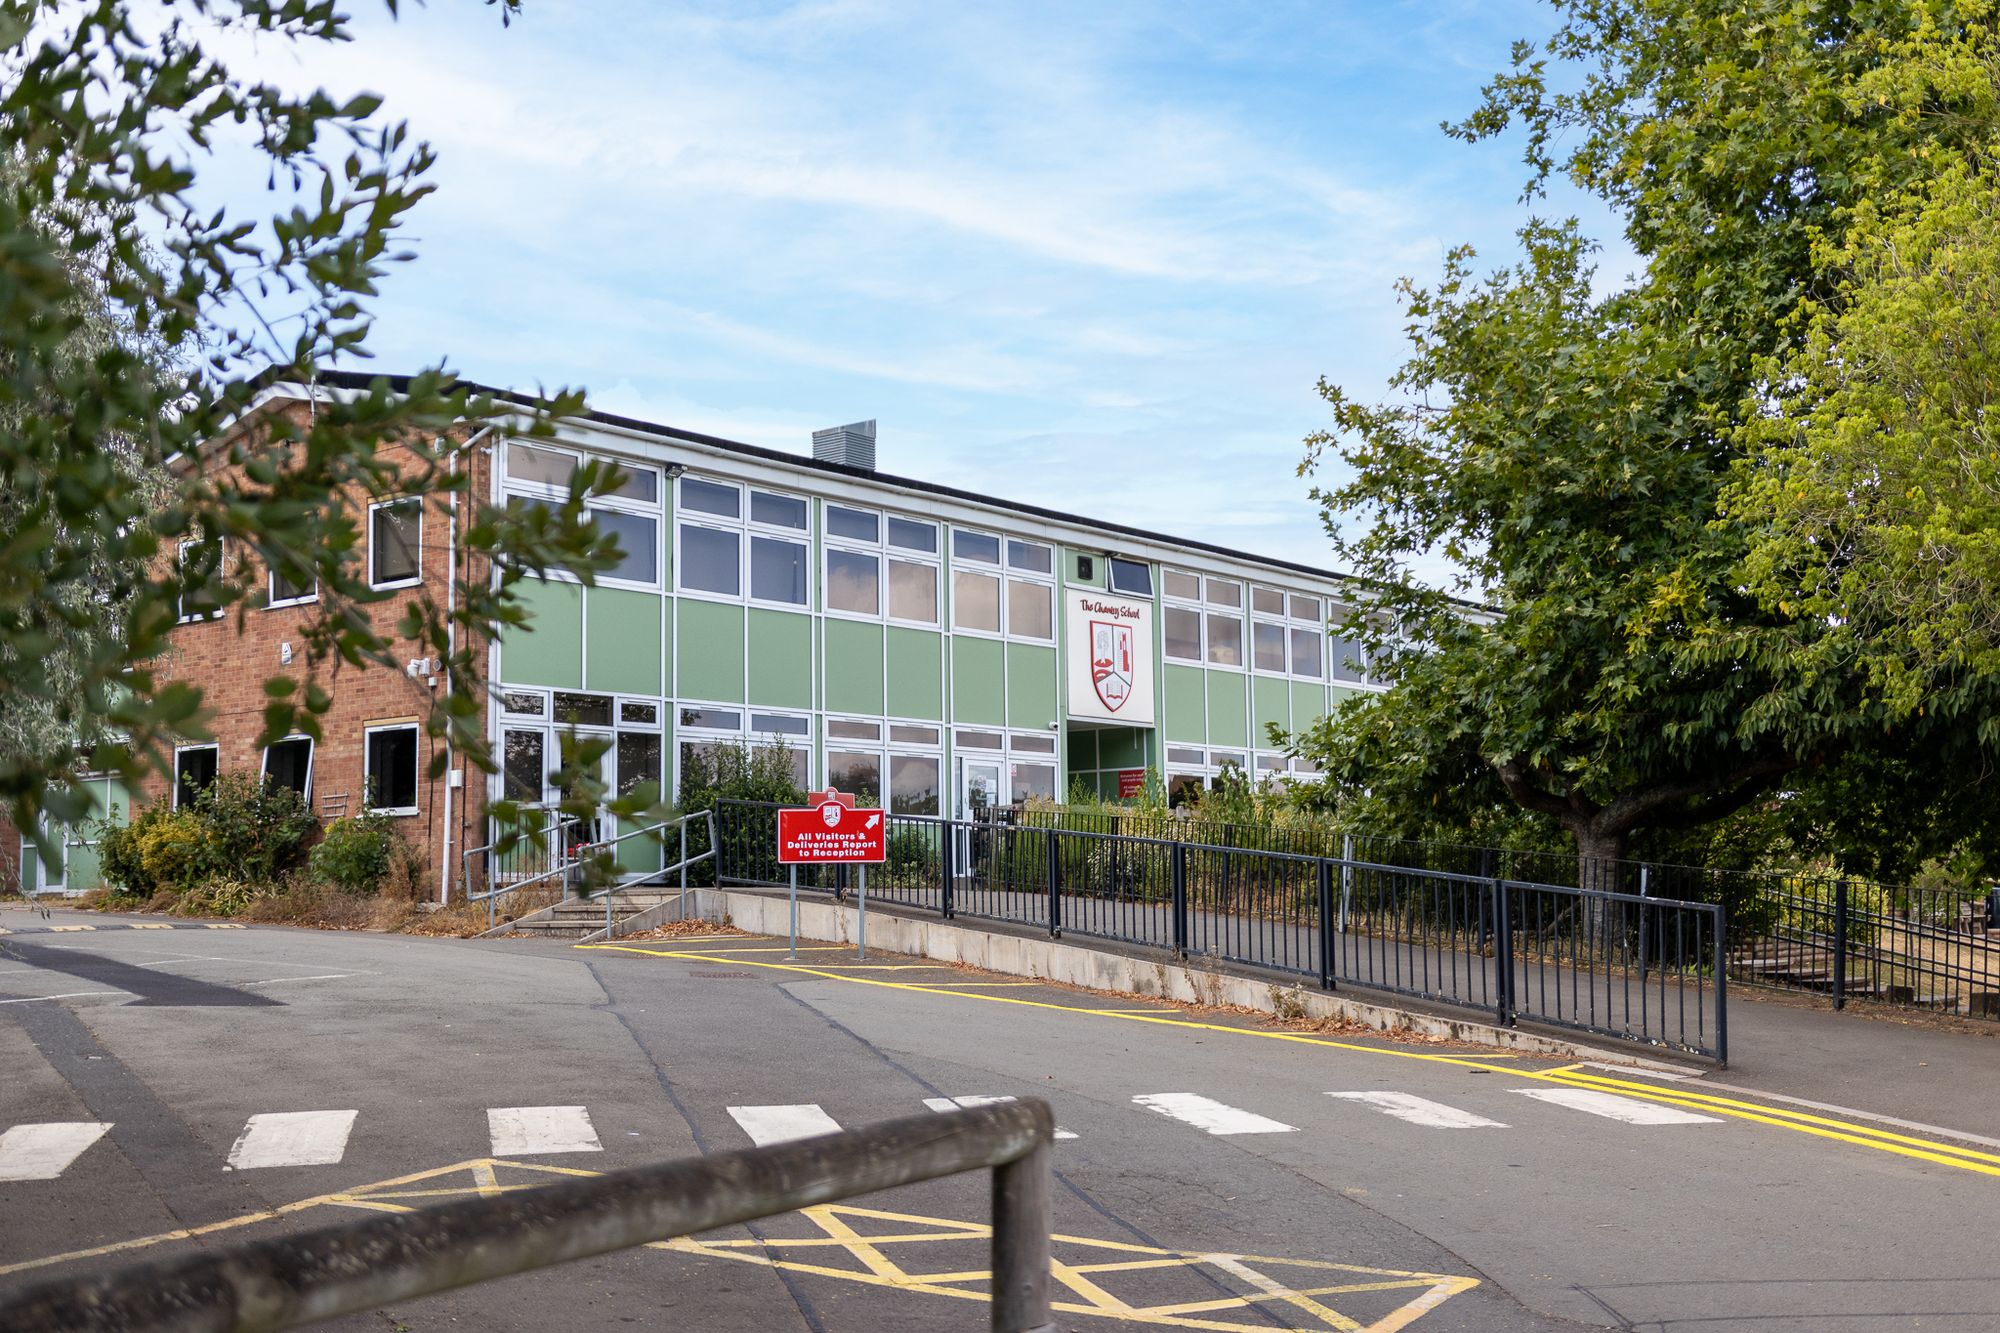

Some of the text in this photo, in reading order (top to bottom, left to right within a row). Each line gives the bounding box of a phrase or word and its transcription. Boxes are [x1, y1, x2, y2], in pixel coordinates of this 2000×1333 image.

[1080, 599, 1093, 611] The
[1120, 606, 1140, 620] School
[815, 832, 855, 840] Visitors
[858, 832, 866, 840] &
[787, 841, 877, 850] Deliveries Report
[799, 849, 865, 858] to Reception
